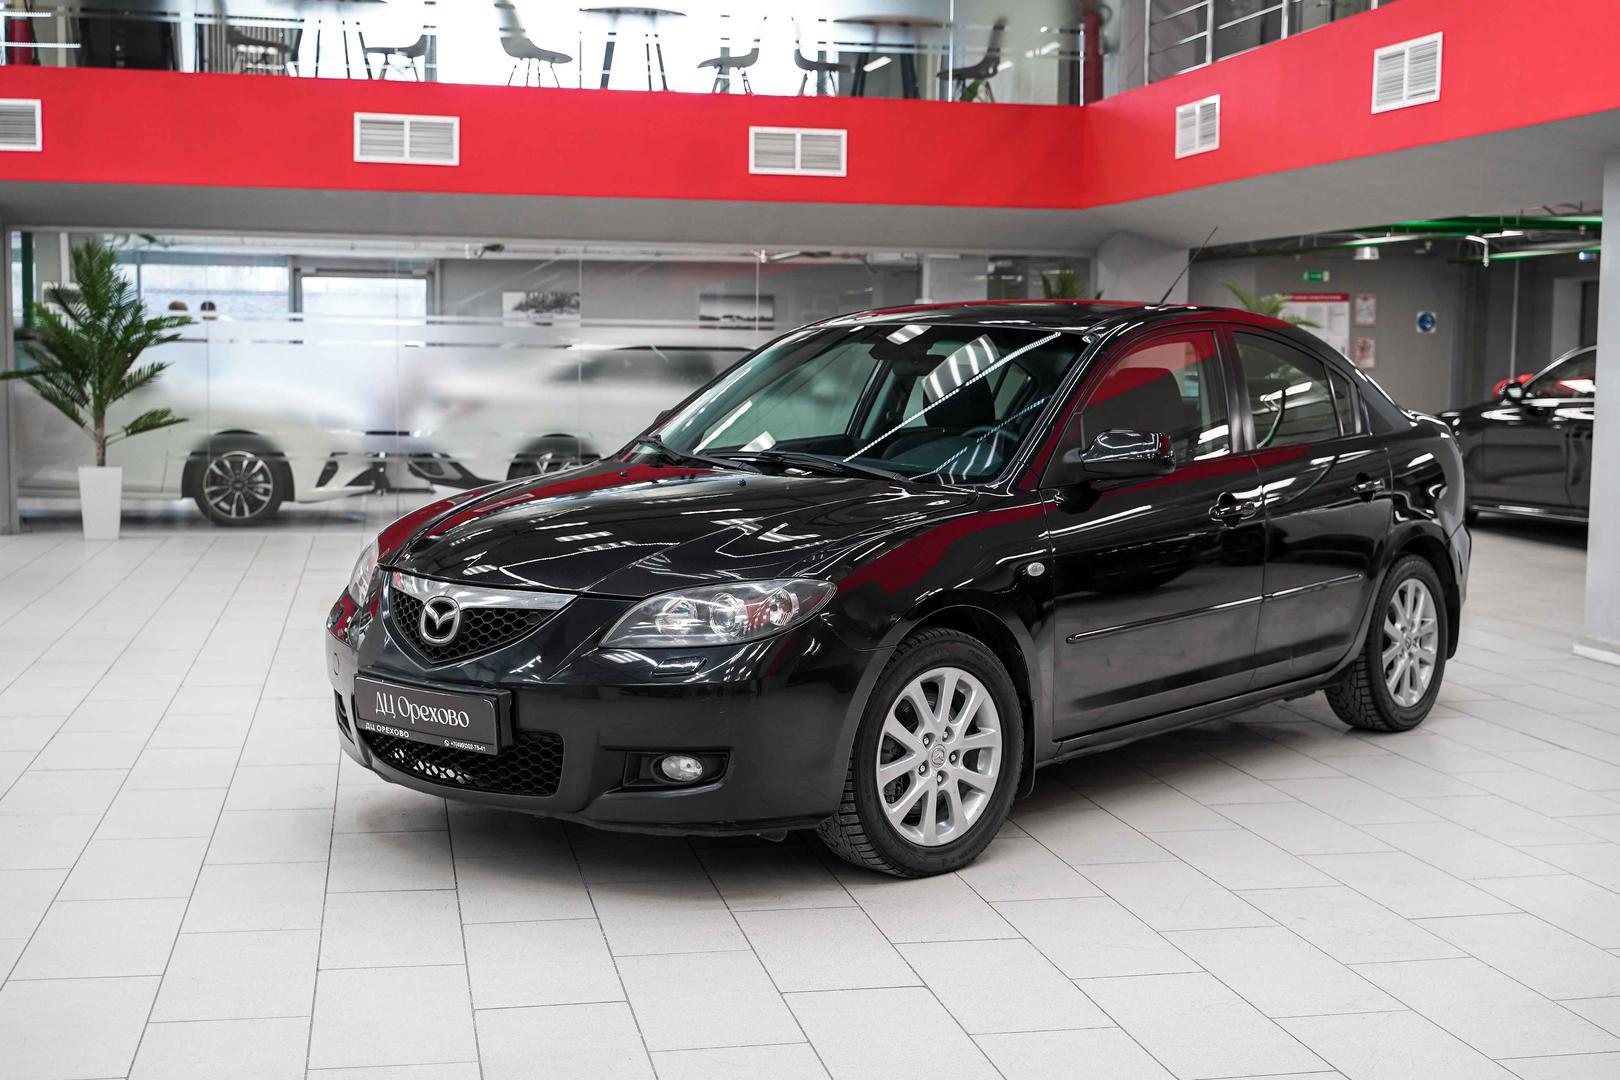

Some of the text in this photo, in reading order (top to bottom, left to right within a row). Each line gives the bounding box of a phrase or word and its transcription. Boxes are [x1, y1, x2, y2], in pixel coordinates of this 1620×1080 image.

[375, 691, 470, 728] ДЦ Орехово
[365, 722, 410, 738] ДЦ ОРЕХОВО
